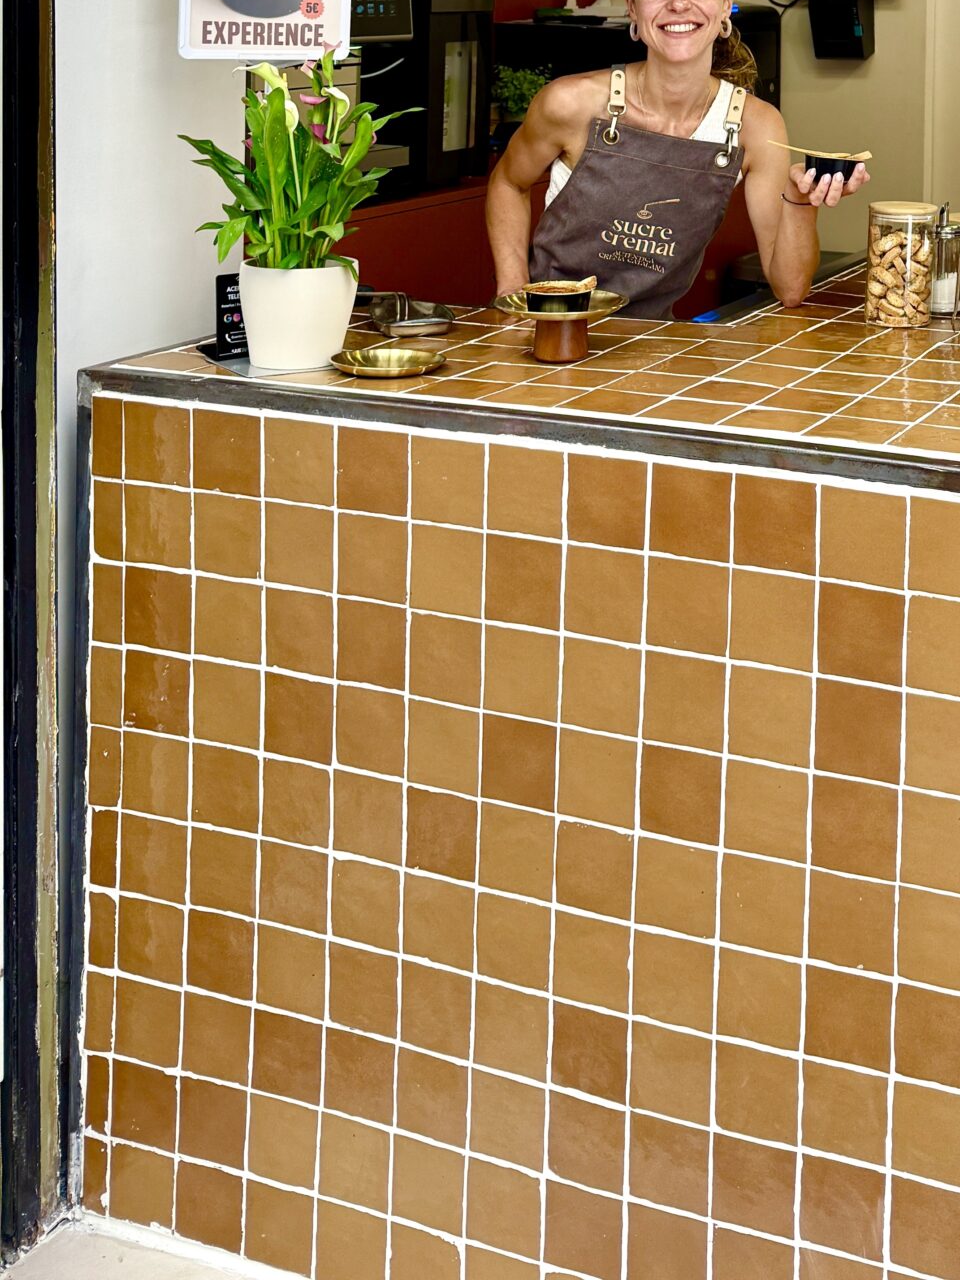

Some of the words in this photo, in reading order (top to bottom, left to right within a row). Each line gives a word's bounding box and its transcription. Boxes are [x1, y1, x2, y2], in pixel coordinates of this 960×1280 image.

[305, 2, 319, 14] 5€
[201, 21, 325, 47] EXPERIENCE
[612, 219, 673, 240] sucre
[601, 230, 676, 257] cremat
